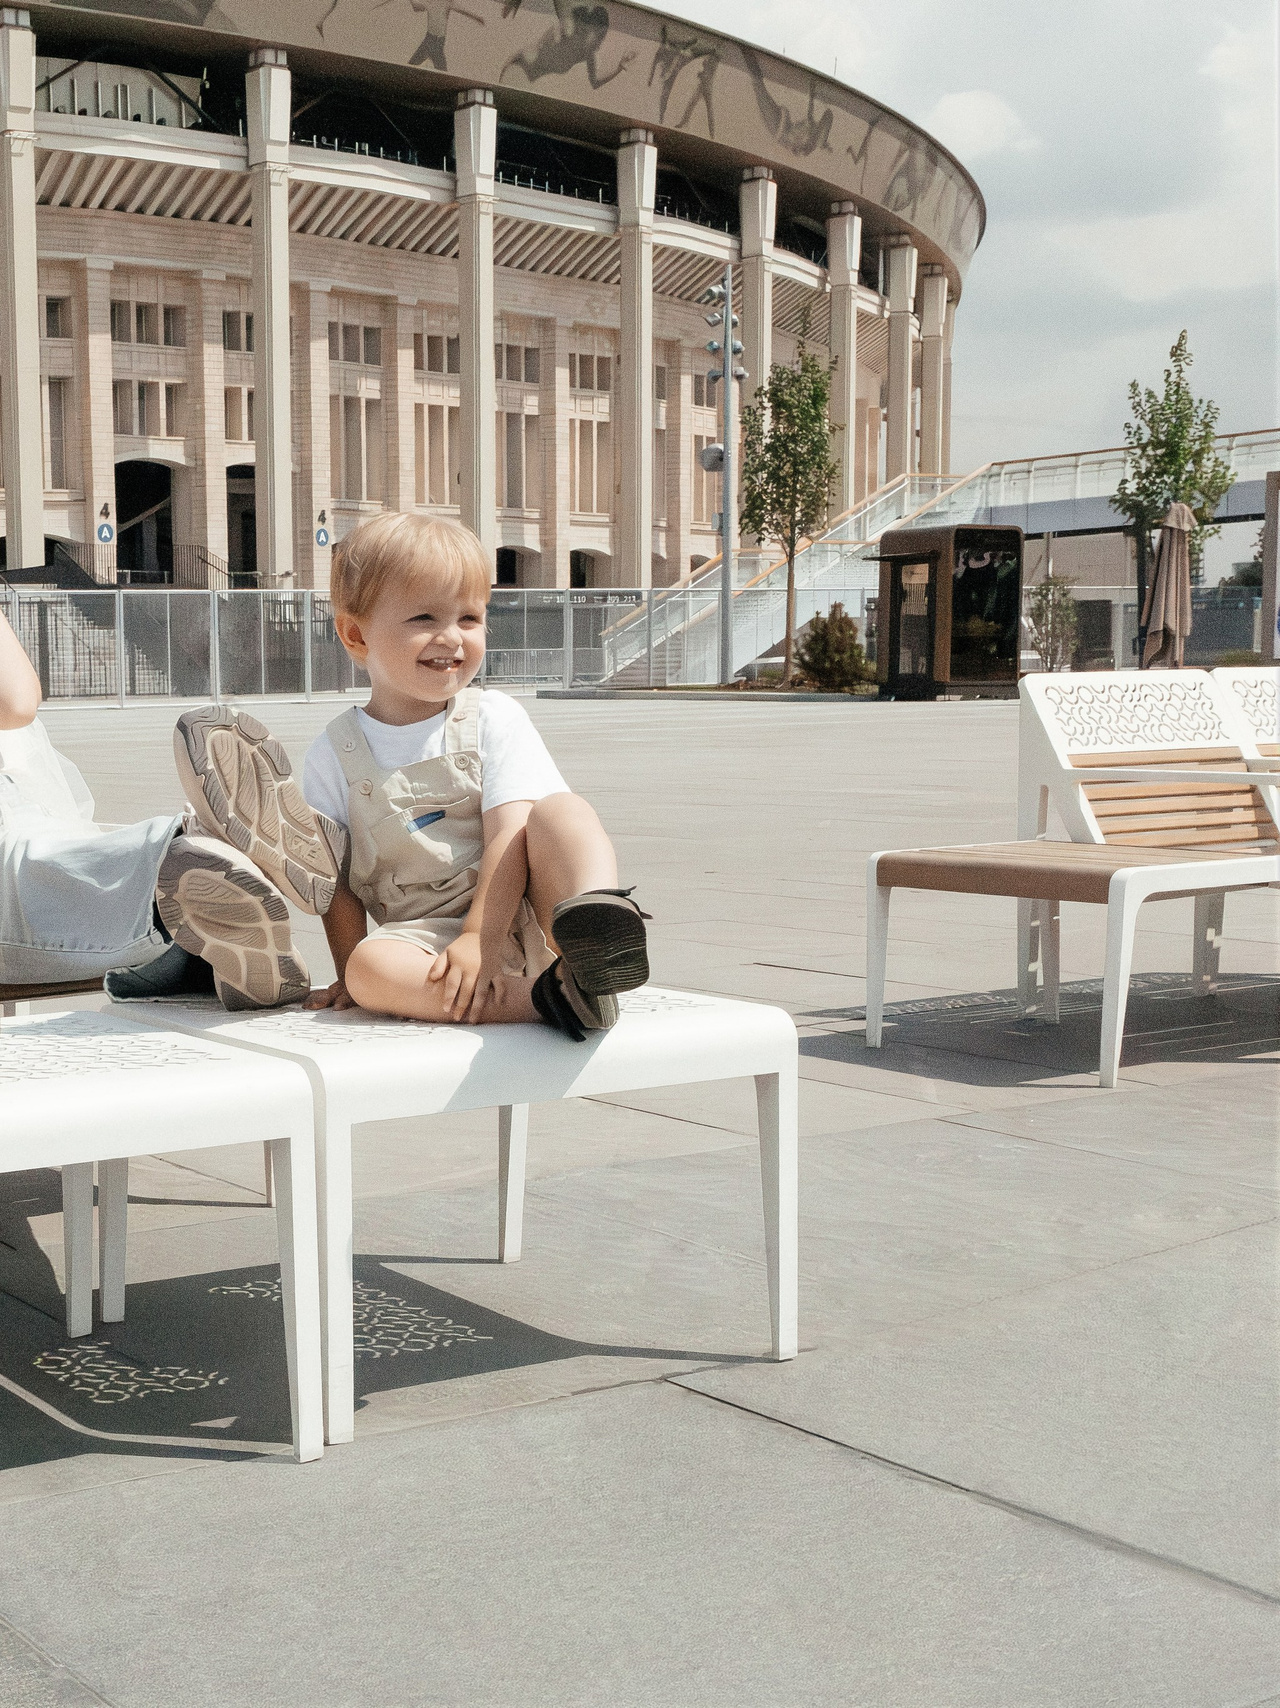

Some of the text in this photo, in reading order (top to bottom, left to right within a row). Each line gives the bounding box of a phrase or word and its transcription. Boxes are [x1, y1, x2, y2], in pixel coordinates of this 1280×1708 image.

[100, 502, 110, 520] 4
[317, 509, 327, 526] 4
[101, 526, 111, 539] A
[318, 531, 327, 543] A
